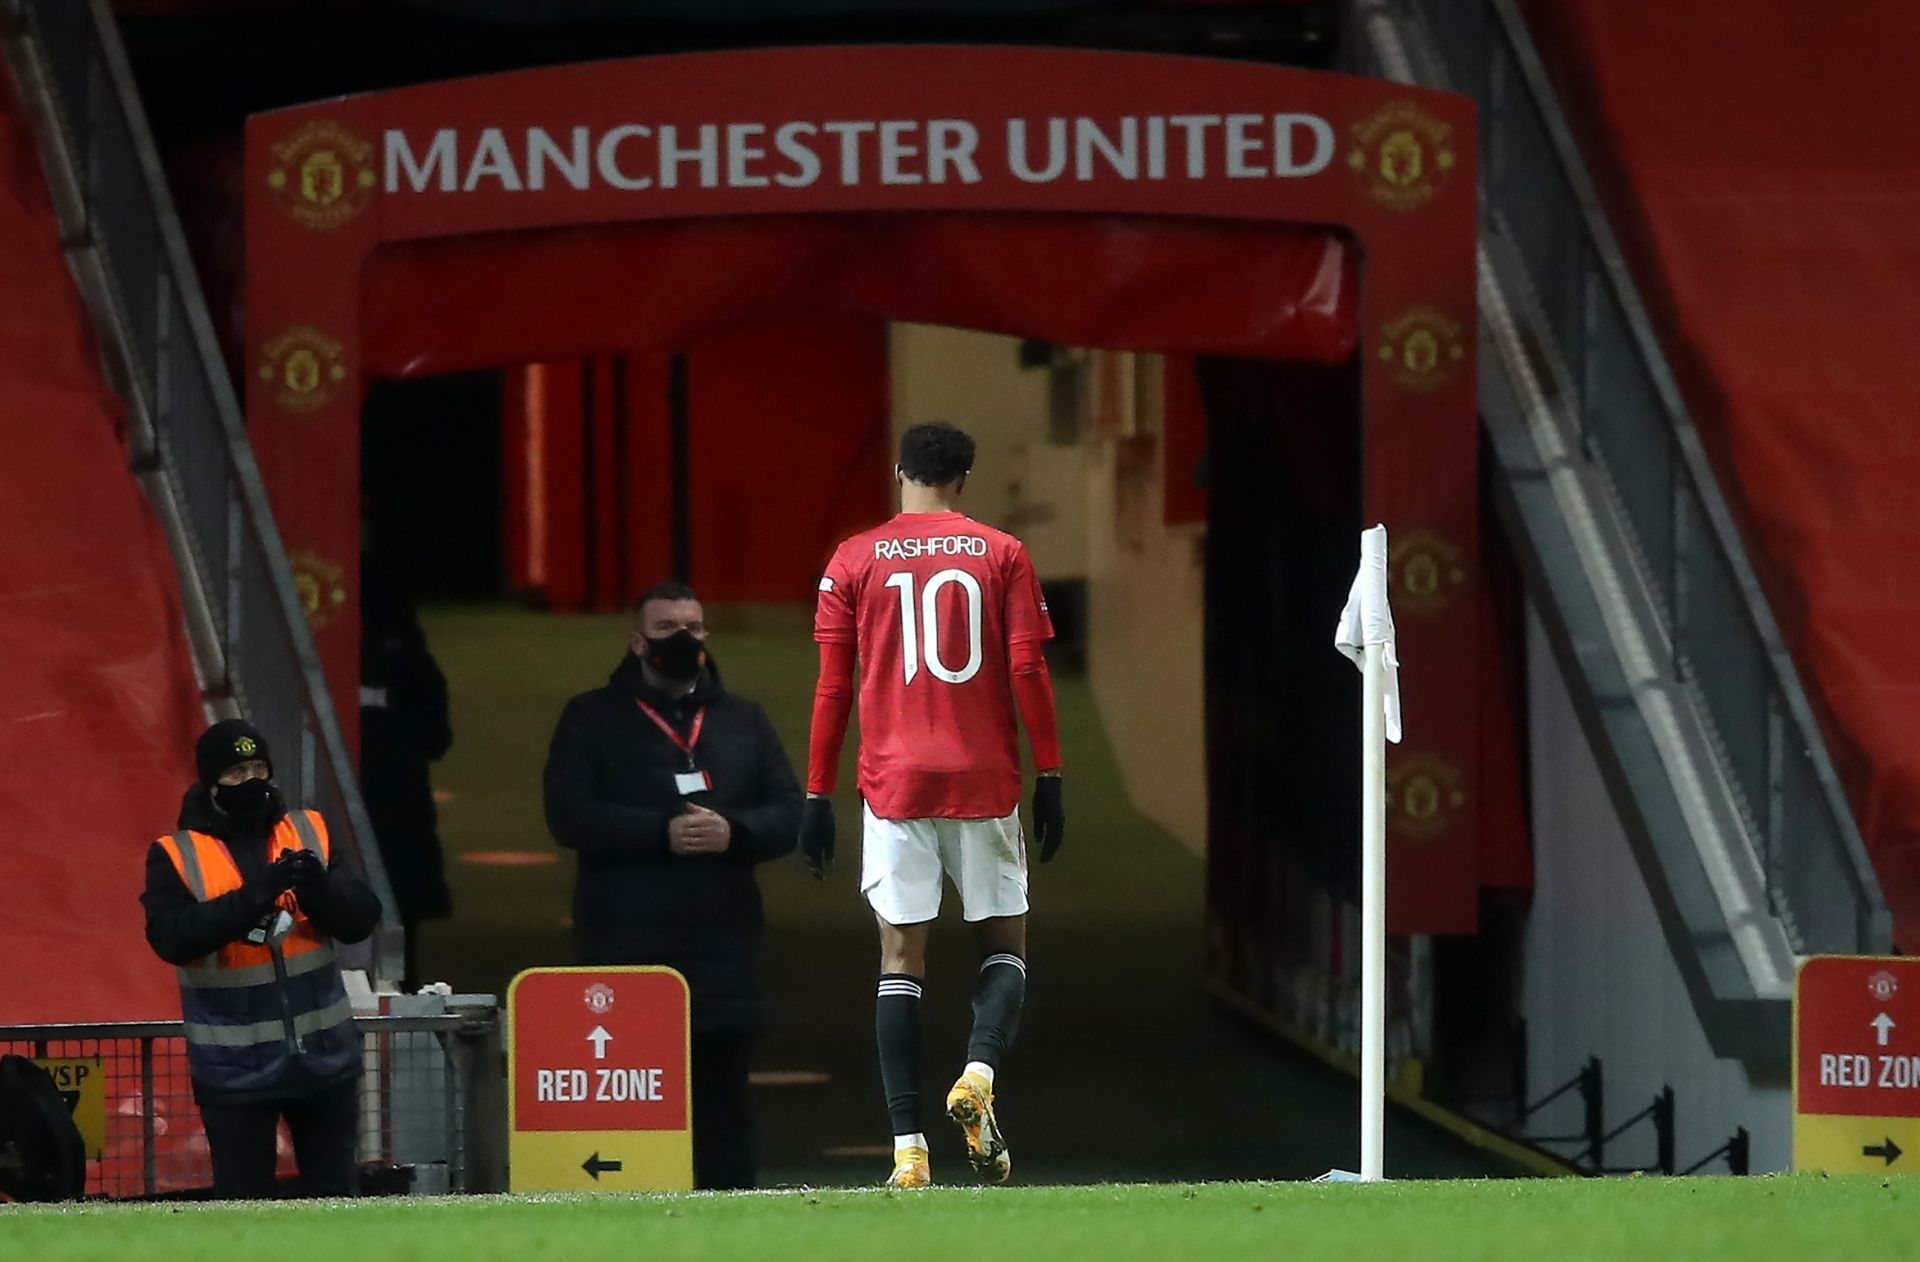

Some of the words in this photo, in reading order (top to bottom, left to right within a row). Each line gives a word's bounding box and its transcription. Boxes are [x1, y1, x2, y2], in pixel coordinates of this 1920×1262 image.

[383, 119, 982, 193] MANCHESTER
[1006, 112, 1335, 184] UNITED
[874, 535, 987, 560] RASHFORD
[884, 568, 983, 687] 10
[537, 1068, 588, 1101] RED
[595, 1068, 664, 1101] ZONE
[1820, 1053, 1871, 1087] RED
